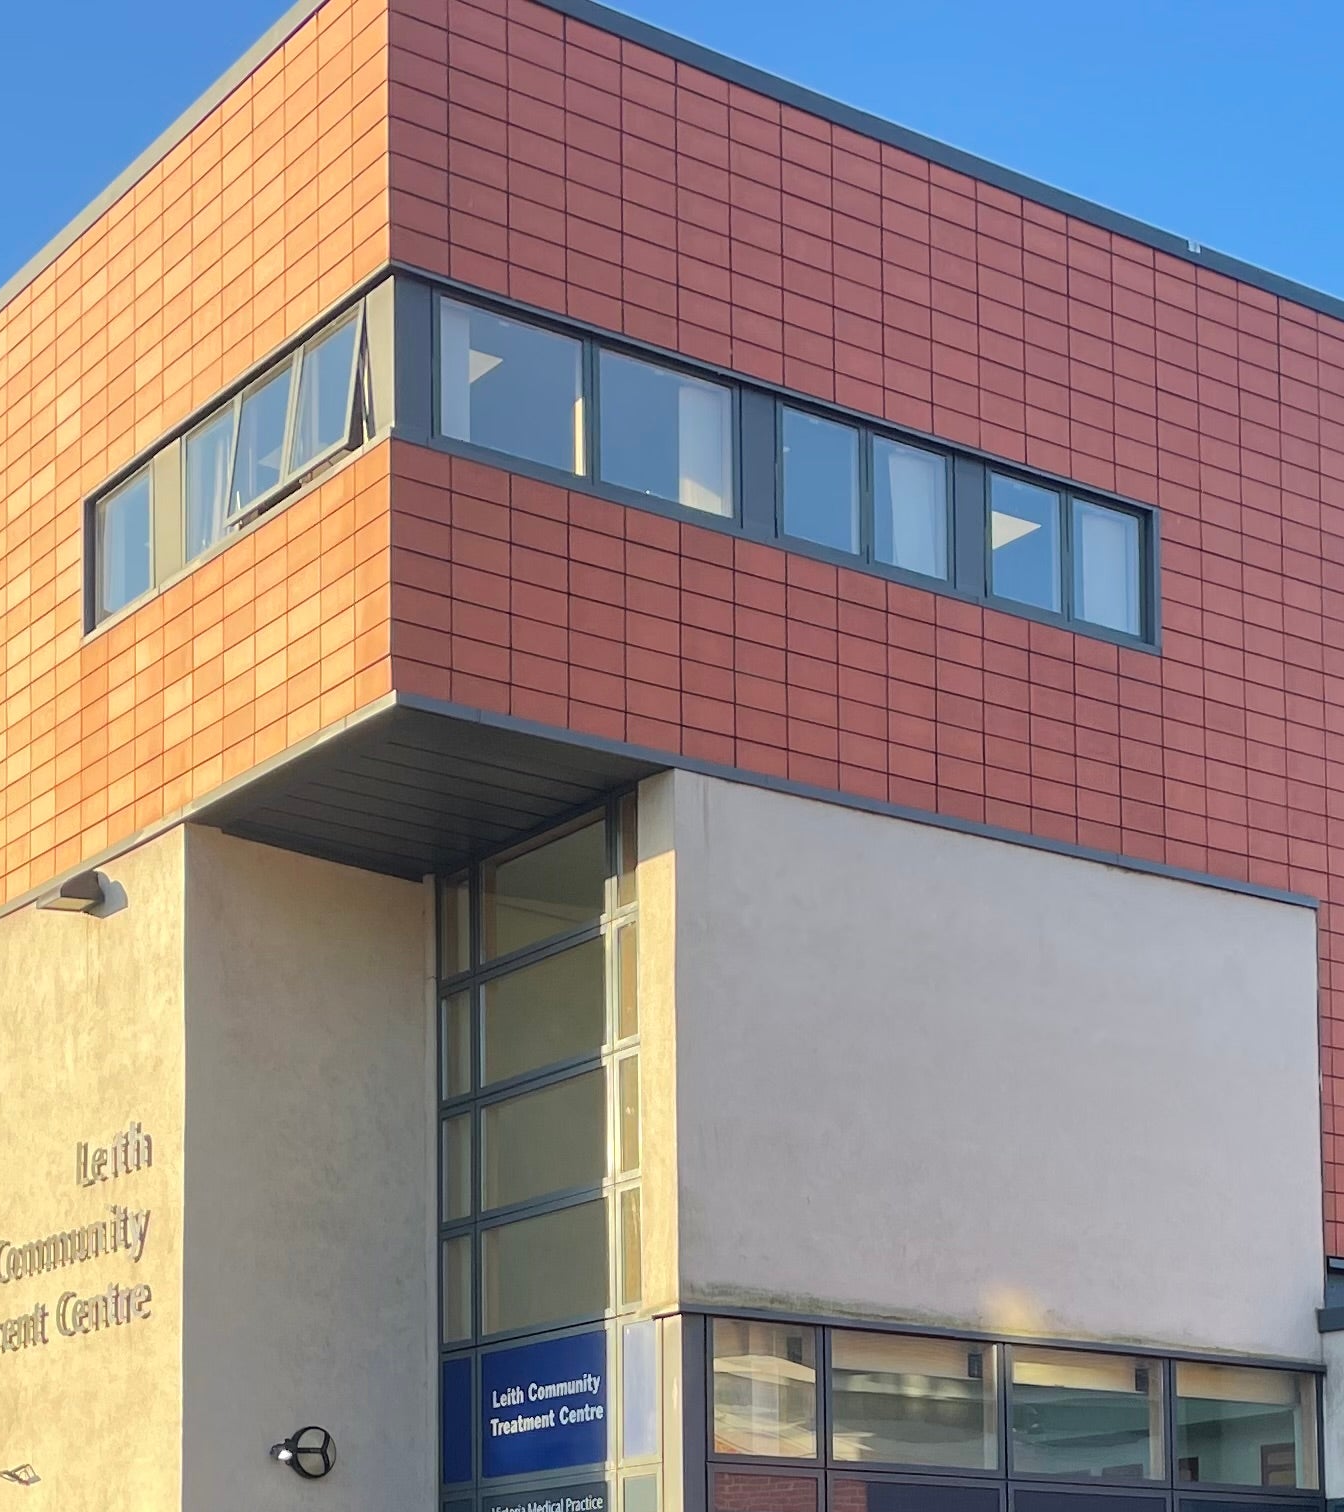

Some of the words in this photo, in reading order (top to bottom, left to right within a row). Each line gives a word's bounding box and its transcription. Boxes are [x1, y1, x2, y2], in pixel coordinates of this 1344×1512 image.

[76, 1121, 153, 1187] Leith
[57, 1282, 151, 1336] Centre
[492, 1387, 524, 1409] Leith
[528, 1373, 601, 1401] Community
[490, 1409, 555, 1437] Treatment
[559, 1404, 604, 1425] Centre
[565, 1494, 604, 1512] Practice
